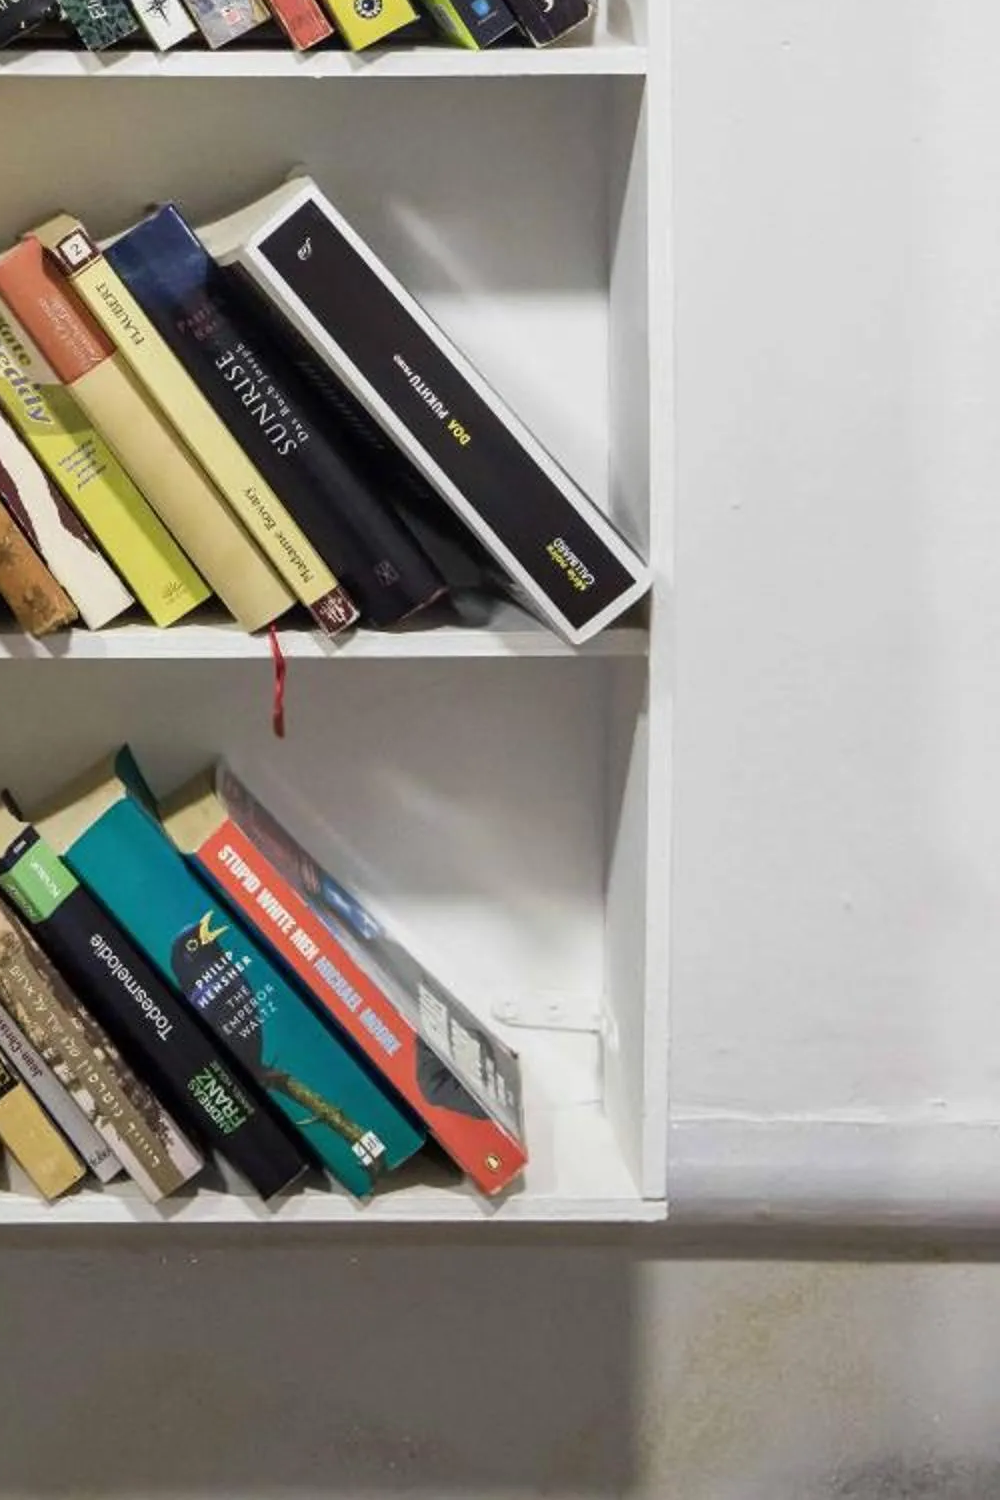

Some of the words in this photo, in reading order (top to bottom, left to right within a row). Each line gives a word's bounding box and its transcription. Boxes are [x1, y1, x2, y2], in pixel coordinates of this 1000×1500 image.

[93, 278, 146, 348] FLAUBERT
[230, 338, 270, 384] Joseph
[209, 348, 301, 459] SUNRISE
[261, 382, 292, 417] Buch
[407, 372, 450, 420] PUKHTU
[285, 416, 311, 444] Das
[444, 416, 472, 446] DOA
[238, 482, 281, 532] Bovary
[269, 529, 316, 584] Madame
[548, 534, 599, 587] GALLIMARD
[212, 842, 265, 897] STUPID
[250, 885, 300, 937] WHITE
[285, 924, 323, 963] MEN
[309, 952, 367, 1014] MICHAEL
[83, 929, 177, 1042] Todesmelodie
[193, 947, 236, 991] PHILIP
[194, 951, 254, 1010] HENSHER
[220, 981, 276, 1036] EMPEROR
[223, 983, 251, 1012] THE
[236, 998, 279, 1040] WALTZ
[195, 1067, 248, 1127] FRANZ
